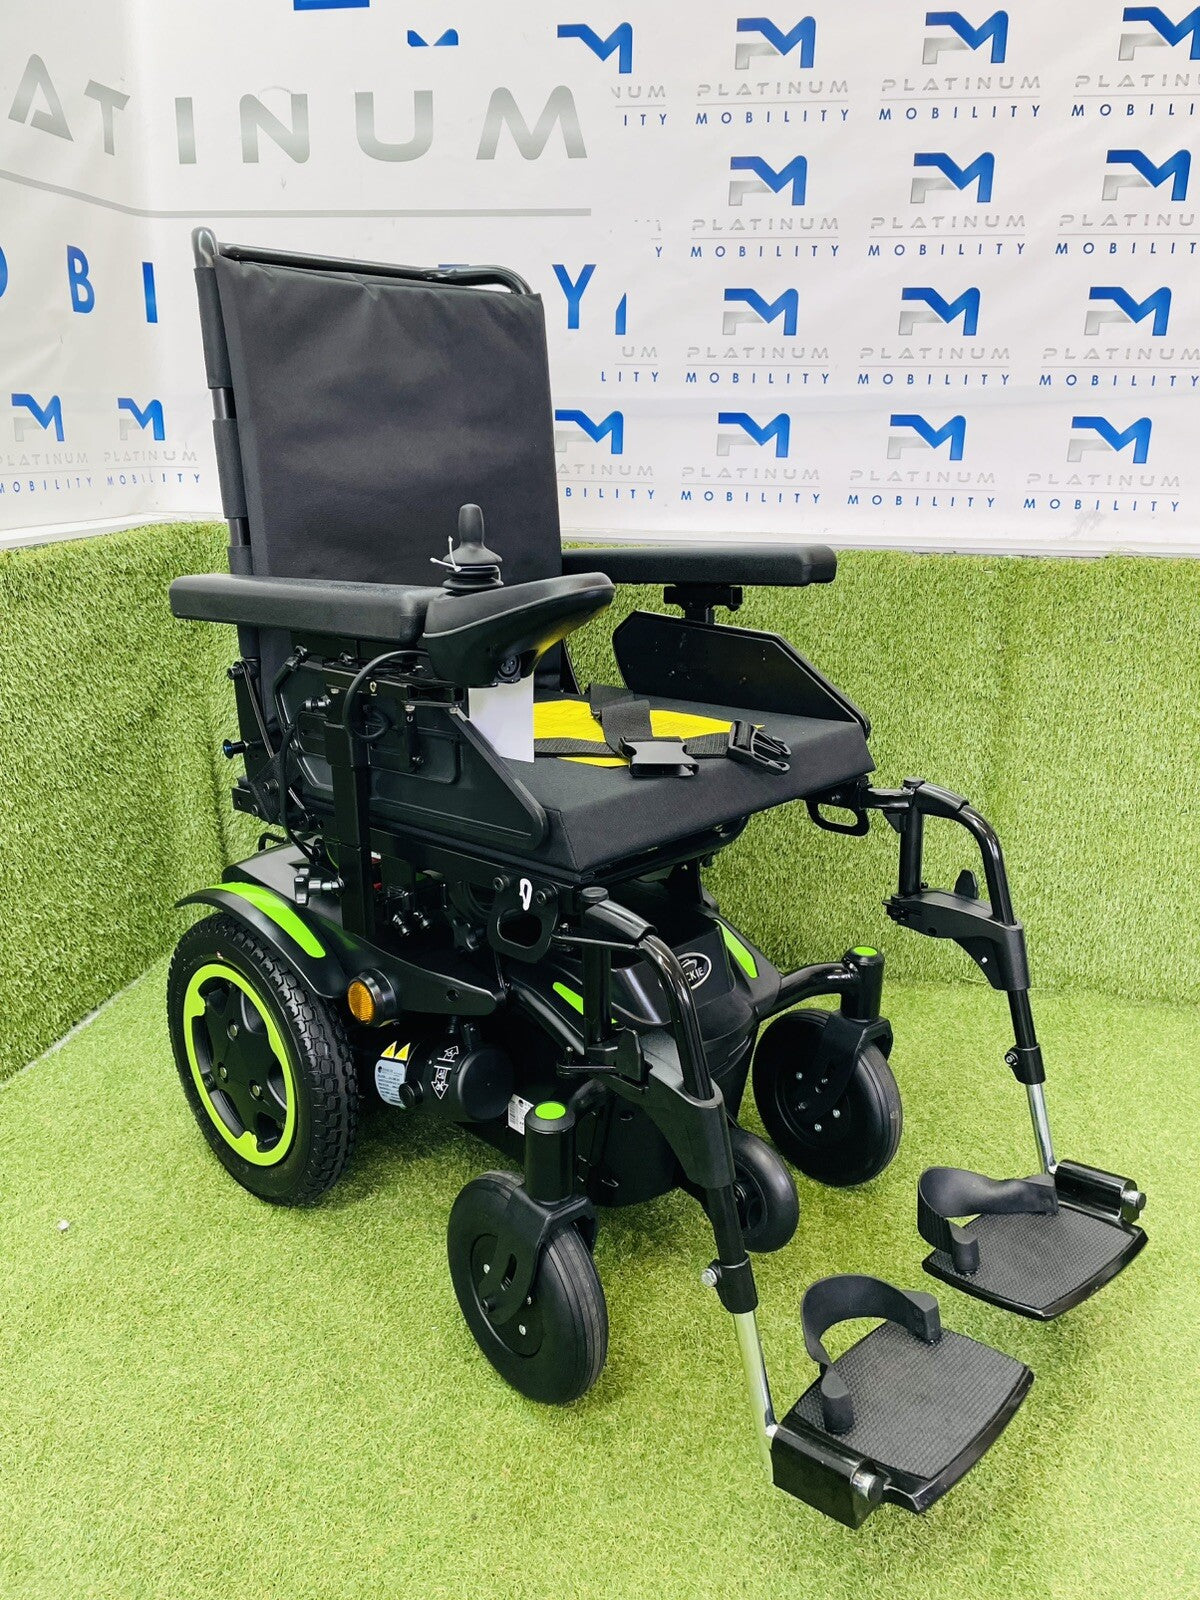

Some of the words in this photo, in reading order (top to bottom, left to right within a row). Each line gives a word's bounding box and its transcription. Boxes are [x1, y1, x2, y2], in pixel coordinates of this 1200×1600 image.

[882, 75, 1040, 91] PLATINUM
[1075, 73, 1200, 87] PLATIN
[697, 80, 848, 96] PLATINUM
[696, 110, 848, 124] MOBILITY
[879, 105, 1040, 120] MOBILITY
[692, 217, 838, 231] PLATINUM
[870, 215, 1025, 229] PLATINUM
[691, 245, 839, 257] MOBILITY
[868, 243, 1025, 256] MOBILITY
[687, 347, 829, 359] PLATINUM
[860, 348, 1010, 359] PLATINUM
[1043, 348, 1200, 360] PLATINUM
[686, 372, 829, 384] MOBILITY
[857, 374, 1009, 385] MOBILITY
[1039, 375, 1200, 387] MOBILITY
[681, 466, 820, 480] PLATINUM
[850, 470, 996, 484] PLATINUM
[1026, 473, 1180, 487] PLATINUM
[681, 491, 820, 503] MOBILITY
[847, 495, 995, 508] MOBILITY
[1023, 498, 1180, 512] MOBILITY
